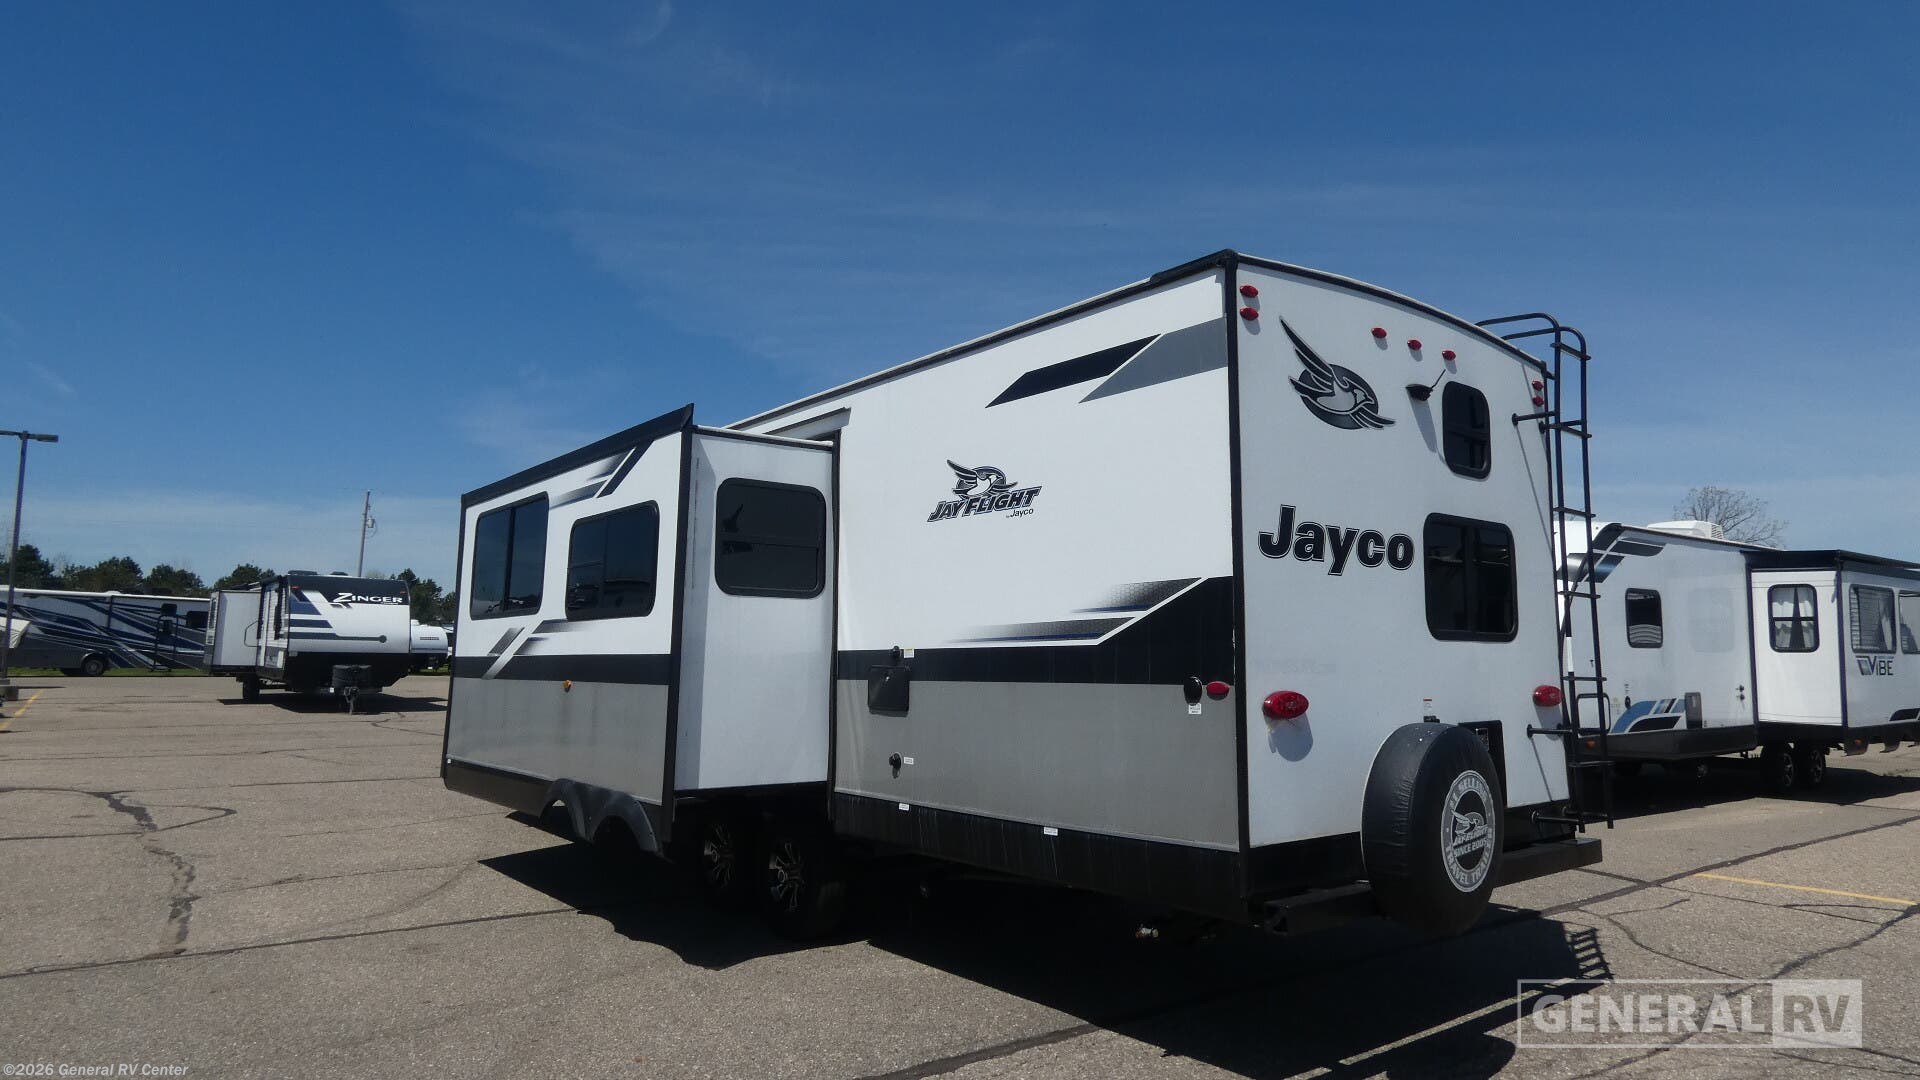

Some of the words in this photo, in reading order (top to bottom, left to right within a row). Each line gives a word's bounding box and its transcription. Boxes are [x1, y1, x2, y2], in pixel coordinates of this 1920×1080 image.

[927, 500, 965, 524] JAY
[961, 486, 1043, 517] FLIGHT
[1010, 508, 1034, 519] Jayco
[1257, 503, 1415, 577] Jayco
[332, 592, 403, 603] ZINGER
